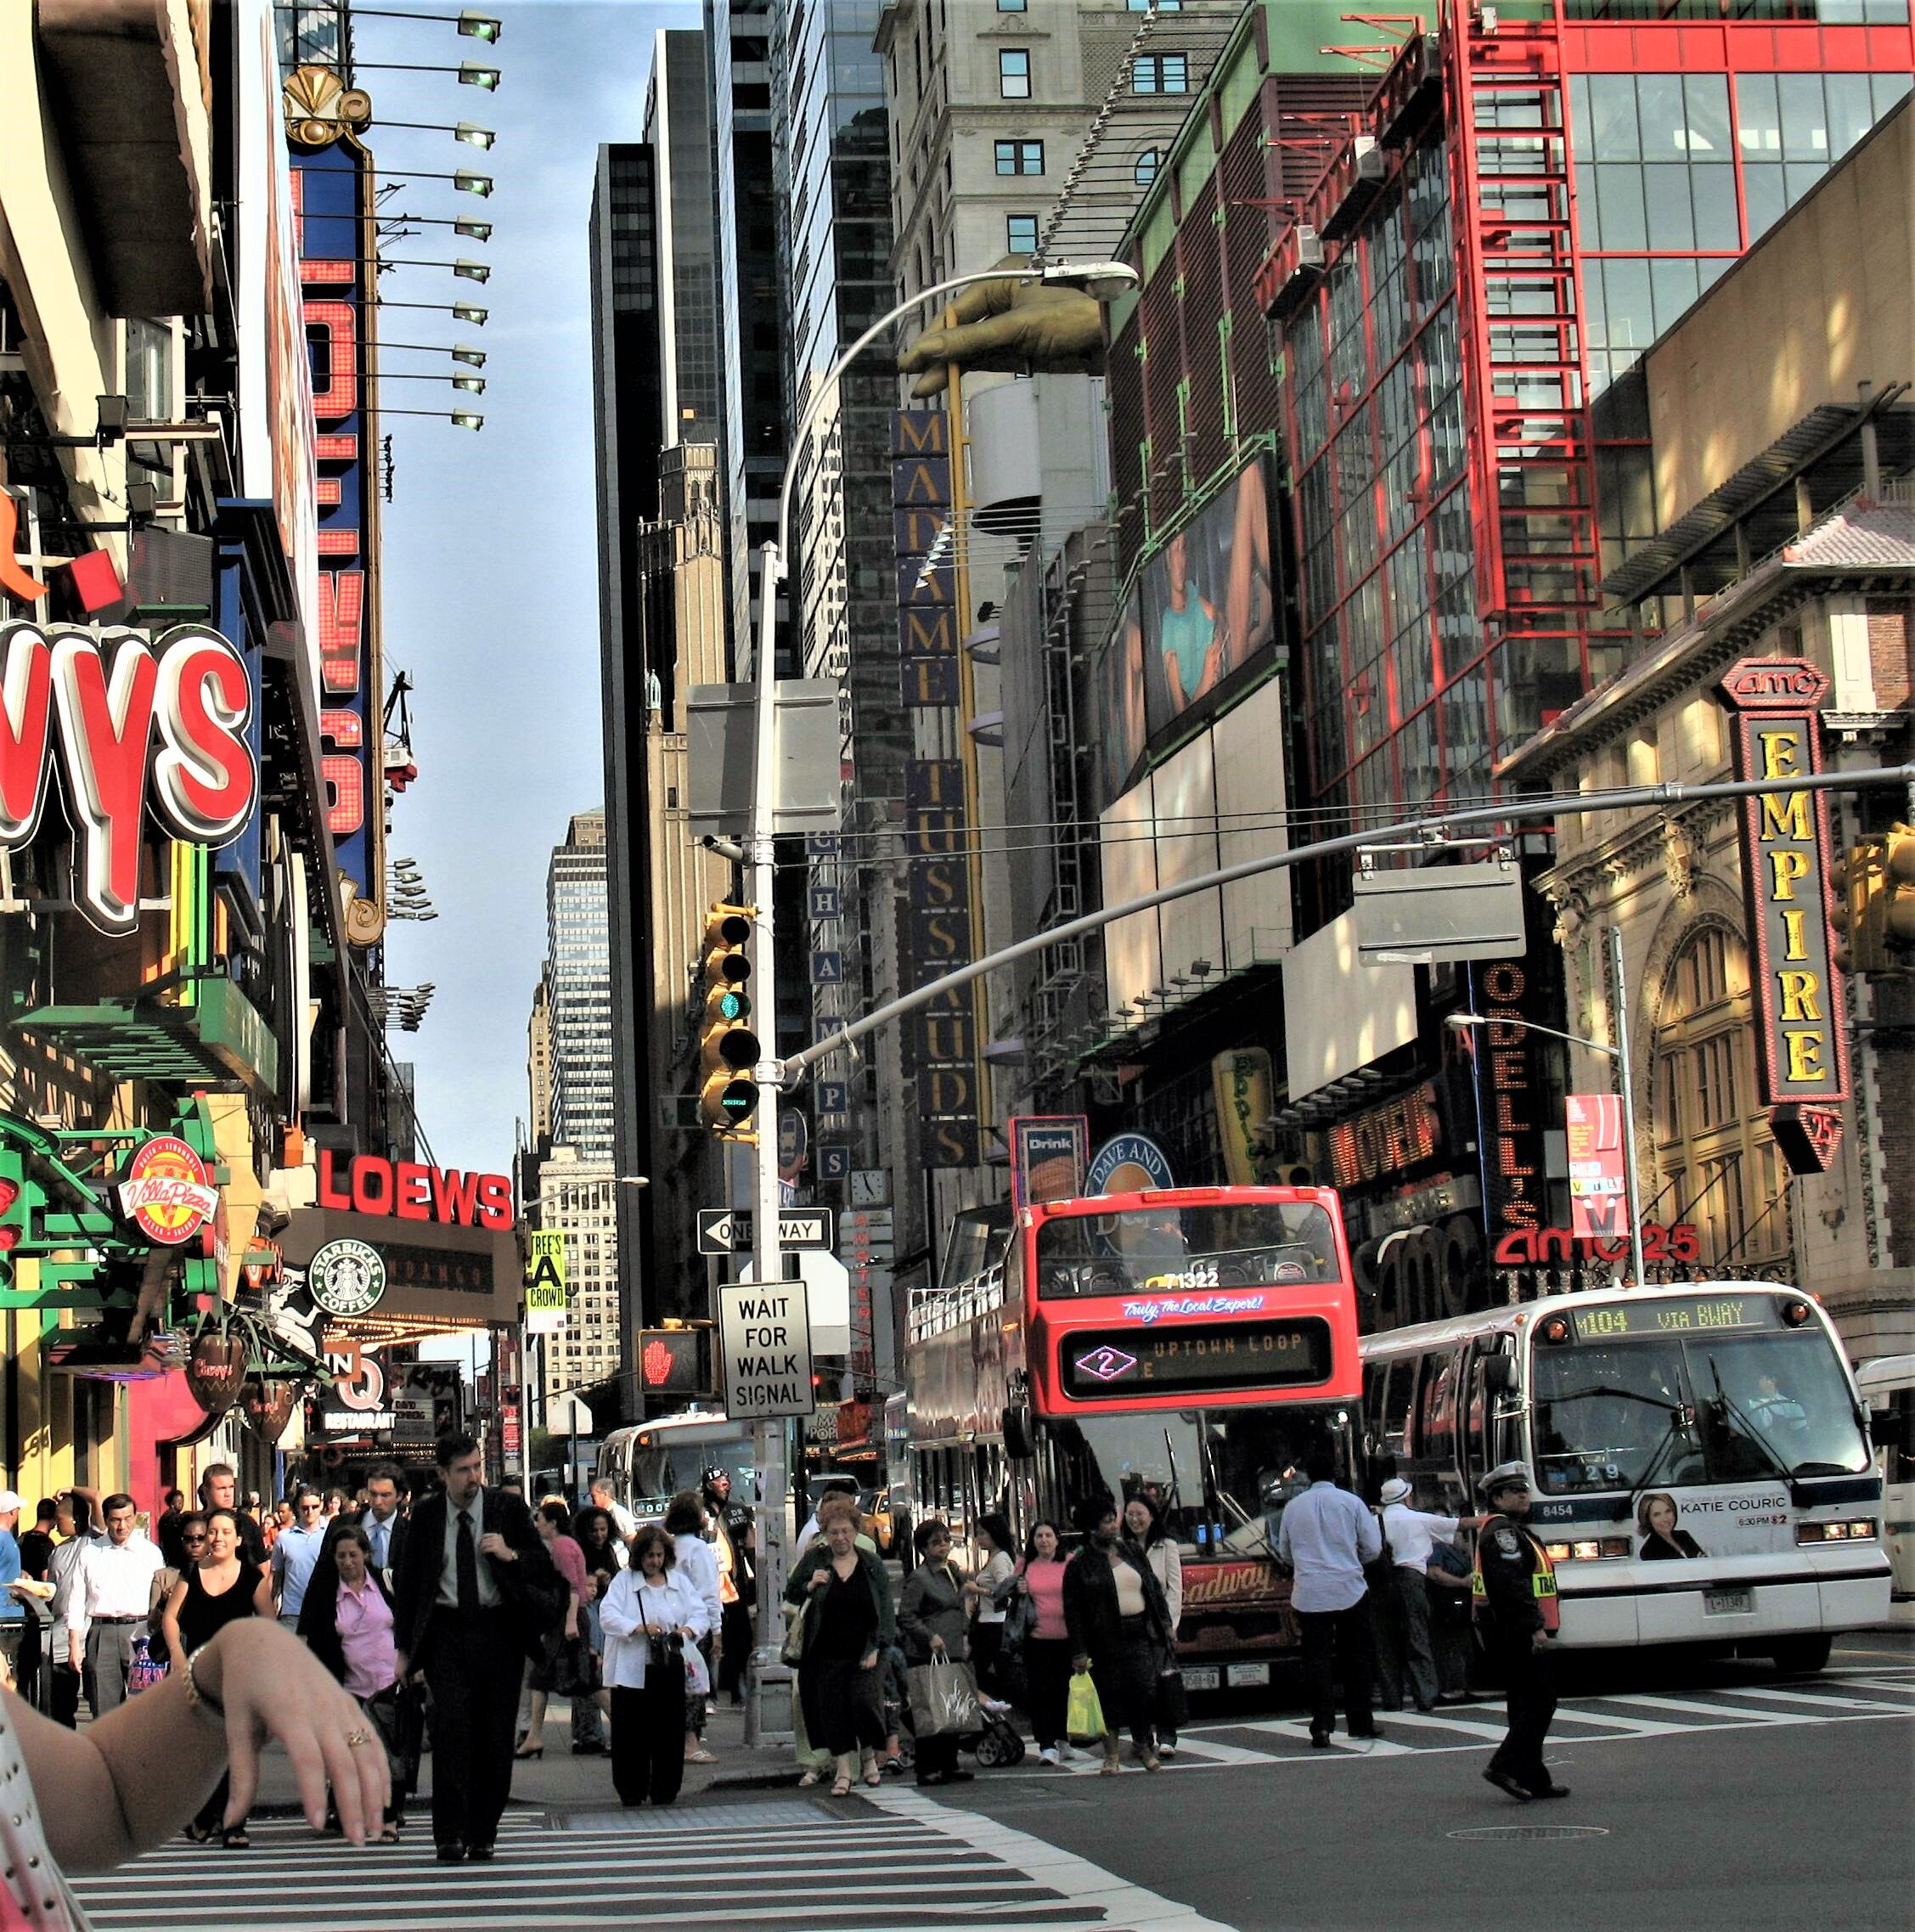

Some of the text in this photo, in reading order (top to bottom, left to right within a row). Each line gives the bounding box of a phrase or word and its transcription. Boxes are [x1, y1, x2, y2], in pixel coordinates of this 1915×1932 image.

[898, 415, 951, 701] MADAME
[1736, 668, 1818, 696] amc
[1758, 731, 1826, 1082] EMPIRE
[1811, 1112, 1833, 1144] 25
[1028, 1139, 1072, 1150] Drink
[1093, 1141, 1163, 1186] DAVE AND
[127, 1177, 211, 1214] Villa Pizza
[319, 1148, 514, 1231] LOEWS
[779, 1222, 813, 1239] WAY
[1495, 1224, 1700, 1264] amc 25
[313, 1243, 382, 1276] STARBUCKS
[526, 1255, 562, 1288] A
[1165, 1272, 1219, 1289] 71322
[320, 1291, 375, 1313] COFFEE
[531, 1287, 564, 1307] CROWD
[1160, 1299, 1179, 1313] The
[1180, 1298, 1212, 1314] Local
[1213, 1296, 1264, 1315] Expert!
[738, 1298, 790, 1320] WAIT
[1657, 1311, 1690, 1329] VIA
[1697, 1302, 1743, 1326] BWAY
[746, 1326, 787, 1349] FOR
[1155, 1333, 1303, 1358] UPTOWN LOOP
[737, 1354, 799, 1377] WALK
[1097, 1351, 1115, 1373] 2
[338, 1357, 385, 1411] Q
[735, 1383, 803, 1406] SIGNAL
[324, 1412, 397, 1429] RESTAURANT
[1681, 1497, 1787, 1514] KATIE COURIC
[1756, 1517, 1770, 1525] PM
